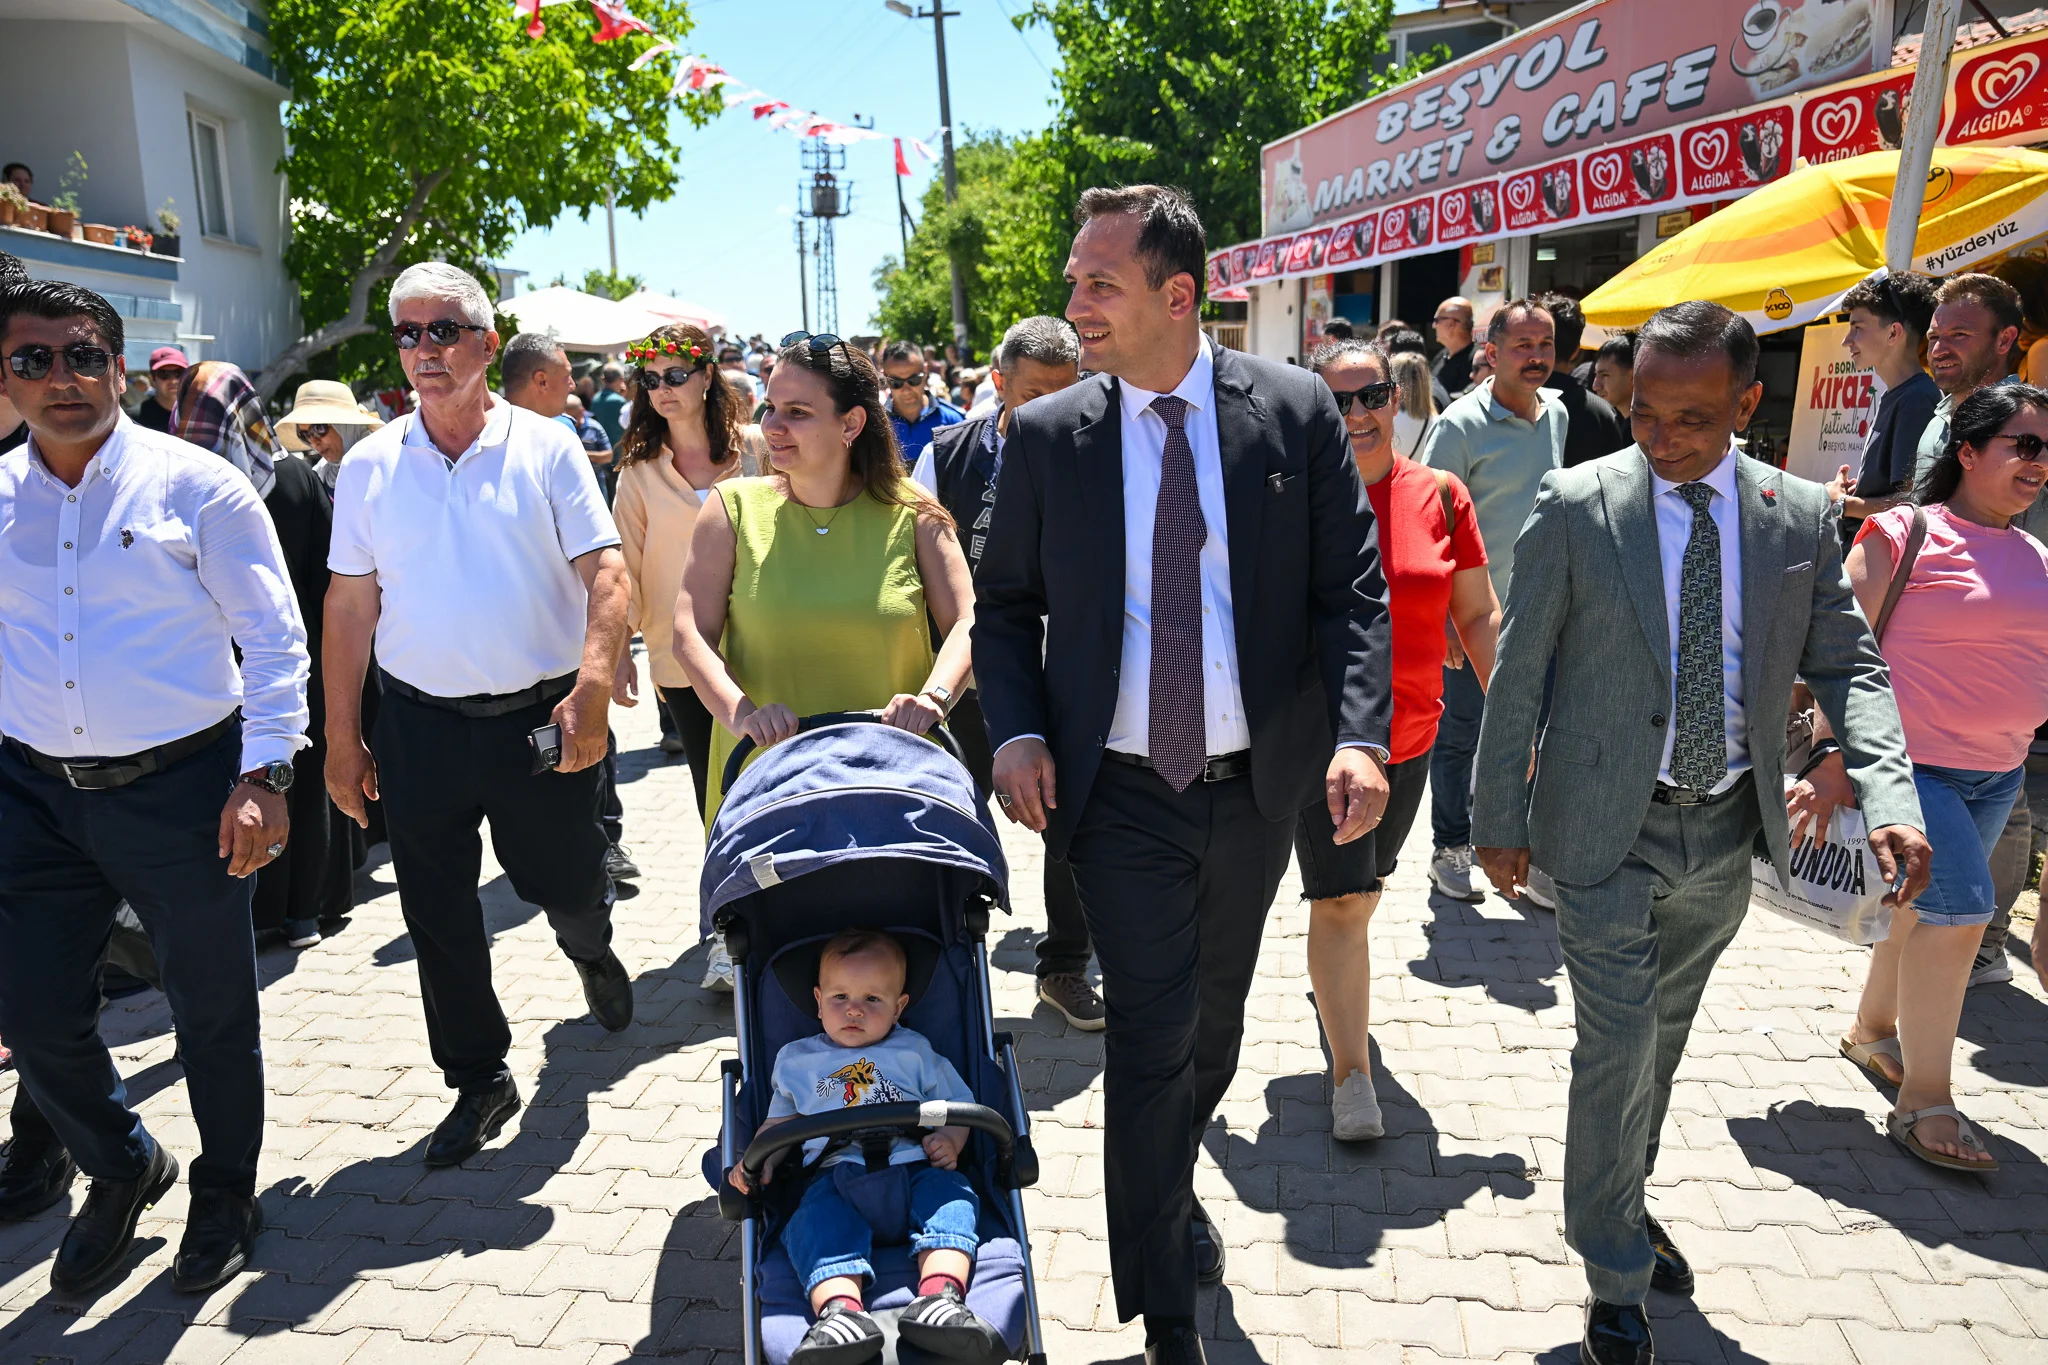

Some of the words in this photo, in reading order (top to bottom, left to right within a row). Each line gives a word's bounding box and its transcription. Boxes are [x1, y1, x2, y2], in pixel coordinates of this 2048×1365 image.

[1376, 18, 1605, 144] BEŞYOL
[1313, 130, 1473, 213] MARKET
[1485, 116, 1521, 163] &
[1542, 45, 1717, 146] CAFE
[1926, 220, 2019, 271] #yüzdeyüz
[1847, 838, 1867, 846] 1997
